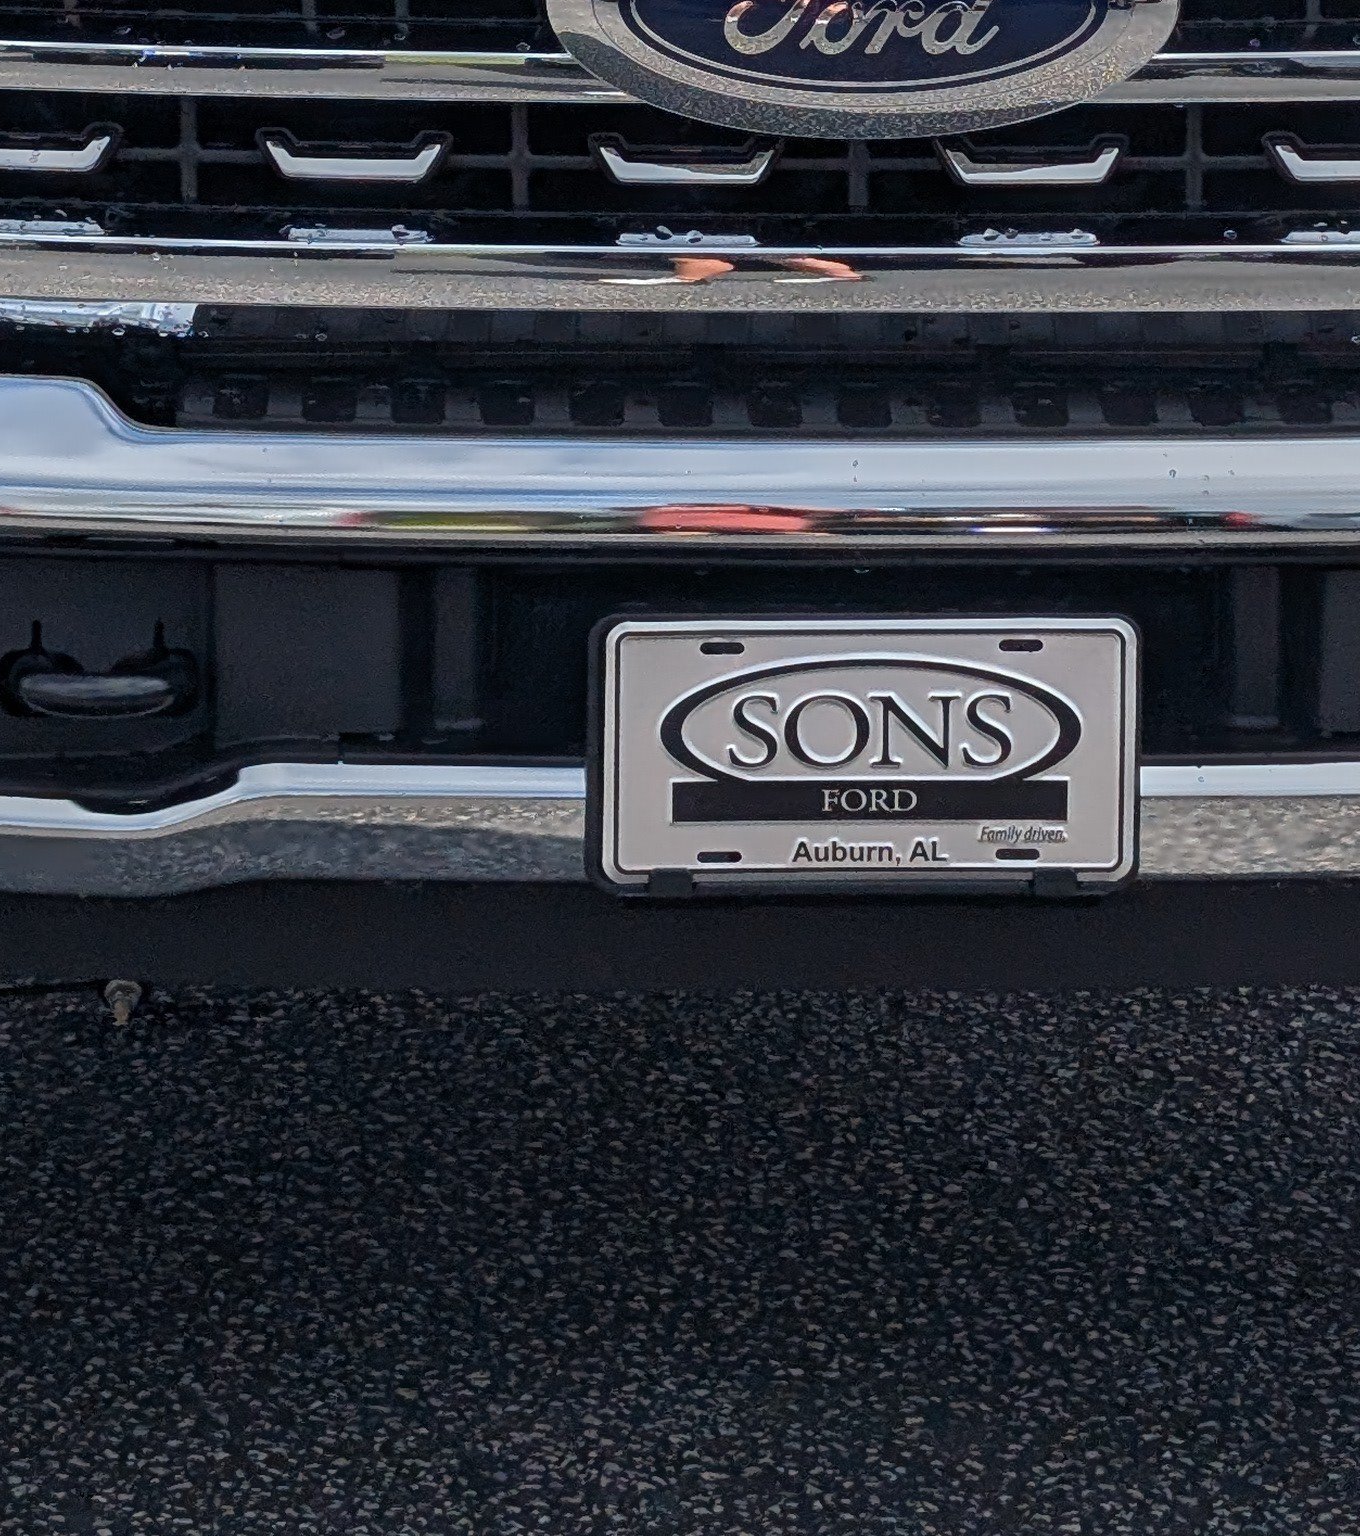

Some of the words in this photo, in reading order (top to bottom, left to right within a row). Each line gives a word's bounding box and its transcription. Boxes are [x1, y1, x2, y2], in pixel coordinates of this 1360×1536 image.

[726, 692, 1014, 768] SONS
[820, 788, 919, 813] FORD
[979, 824, 1023, 844] Family
[791, 840, 902, 866] Auburn,
[908, 840, 949, 863] AL
